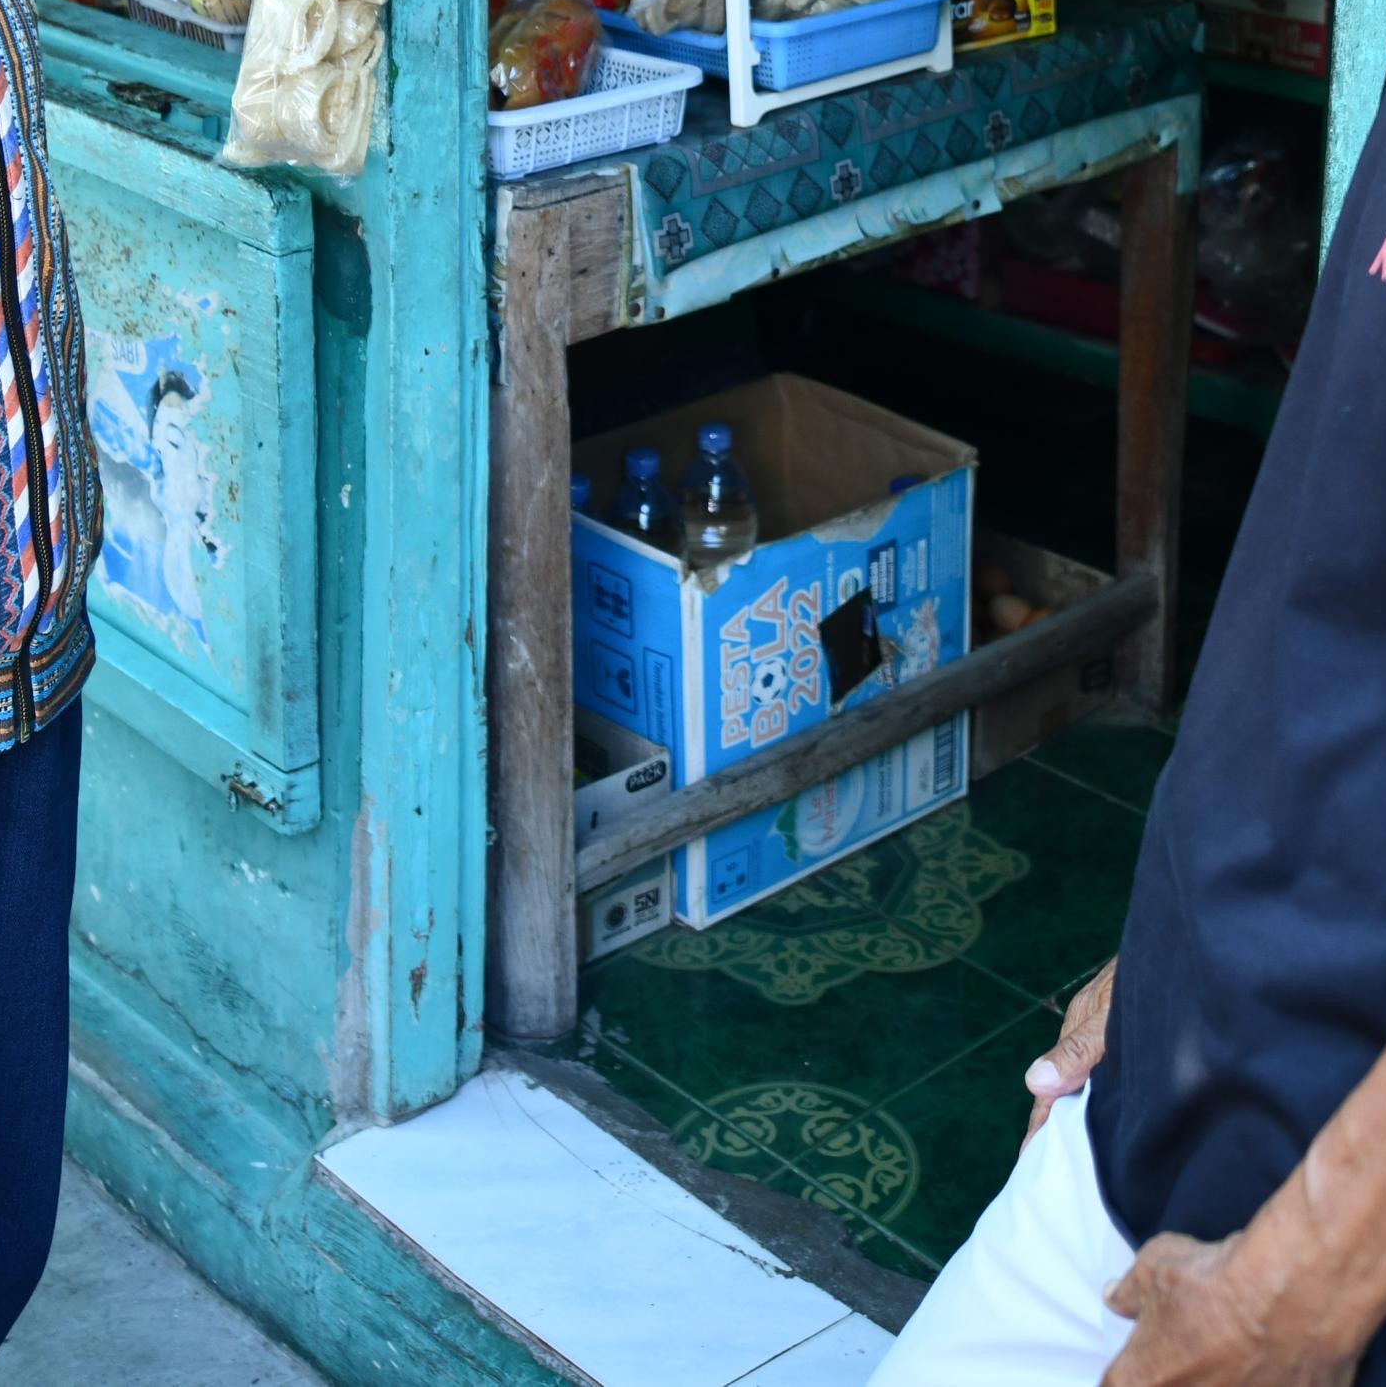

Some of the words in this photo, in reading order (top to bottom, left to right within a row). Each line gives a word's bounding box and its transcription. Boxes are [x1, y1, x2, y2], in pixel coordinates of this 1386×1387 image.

[719, 604, 753, 749] PESTA
[787, 581, 822, 716] 2022
[629, 764, 665, 789] PACK
